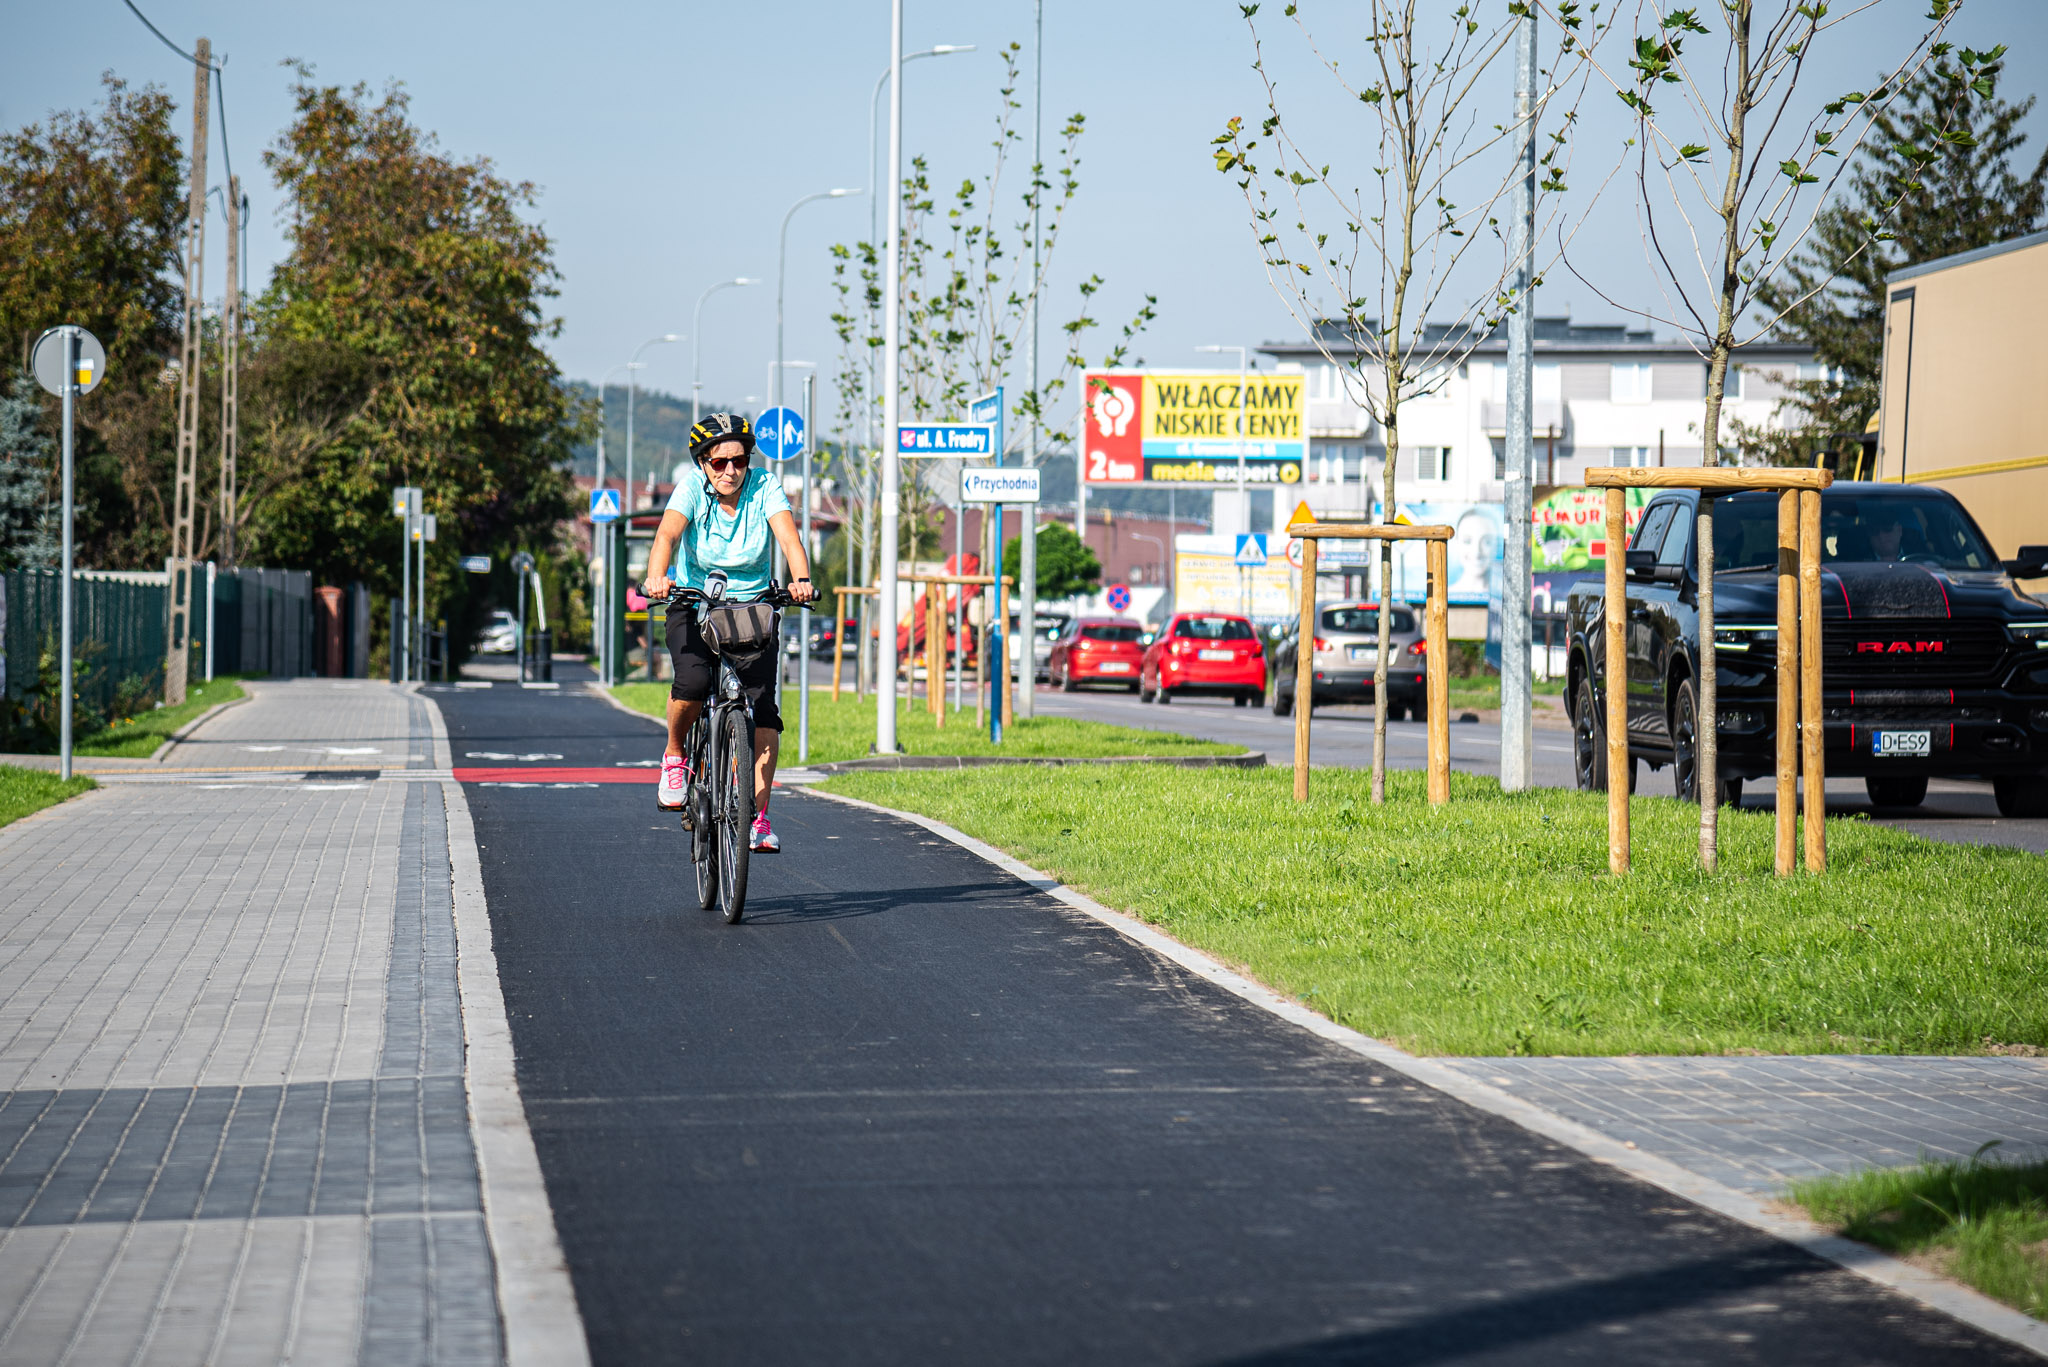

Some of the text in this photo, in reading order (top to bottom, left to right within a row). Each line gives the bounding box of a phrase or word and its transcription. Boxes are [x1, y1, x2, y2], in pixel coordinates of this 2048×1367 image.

[1156, 413, 1298, 436] NISKIE CENY!
[916, 430, 986, 452] ul. A. Fredry
[1089, 450, 1135, 480] 2 km
[973, 476, 1038, 493] Przychodnia
[1531, 508, 1600, 526] LEMUR
[1857, 641, 1943, 653] RAM
